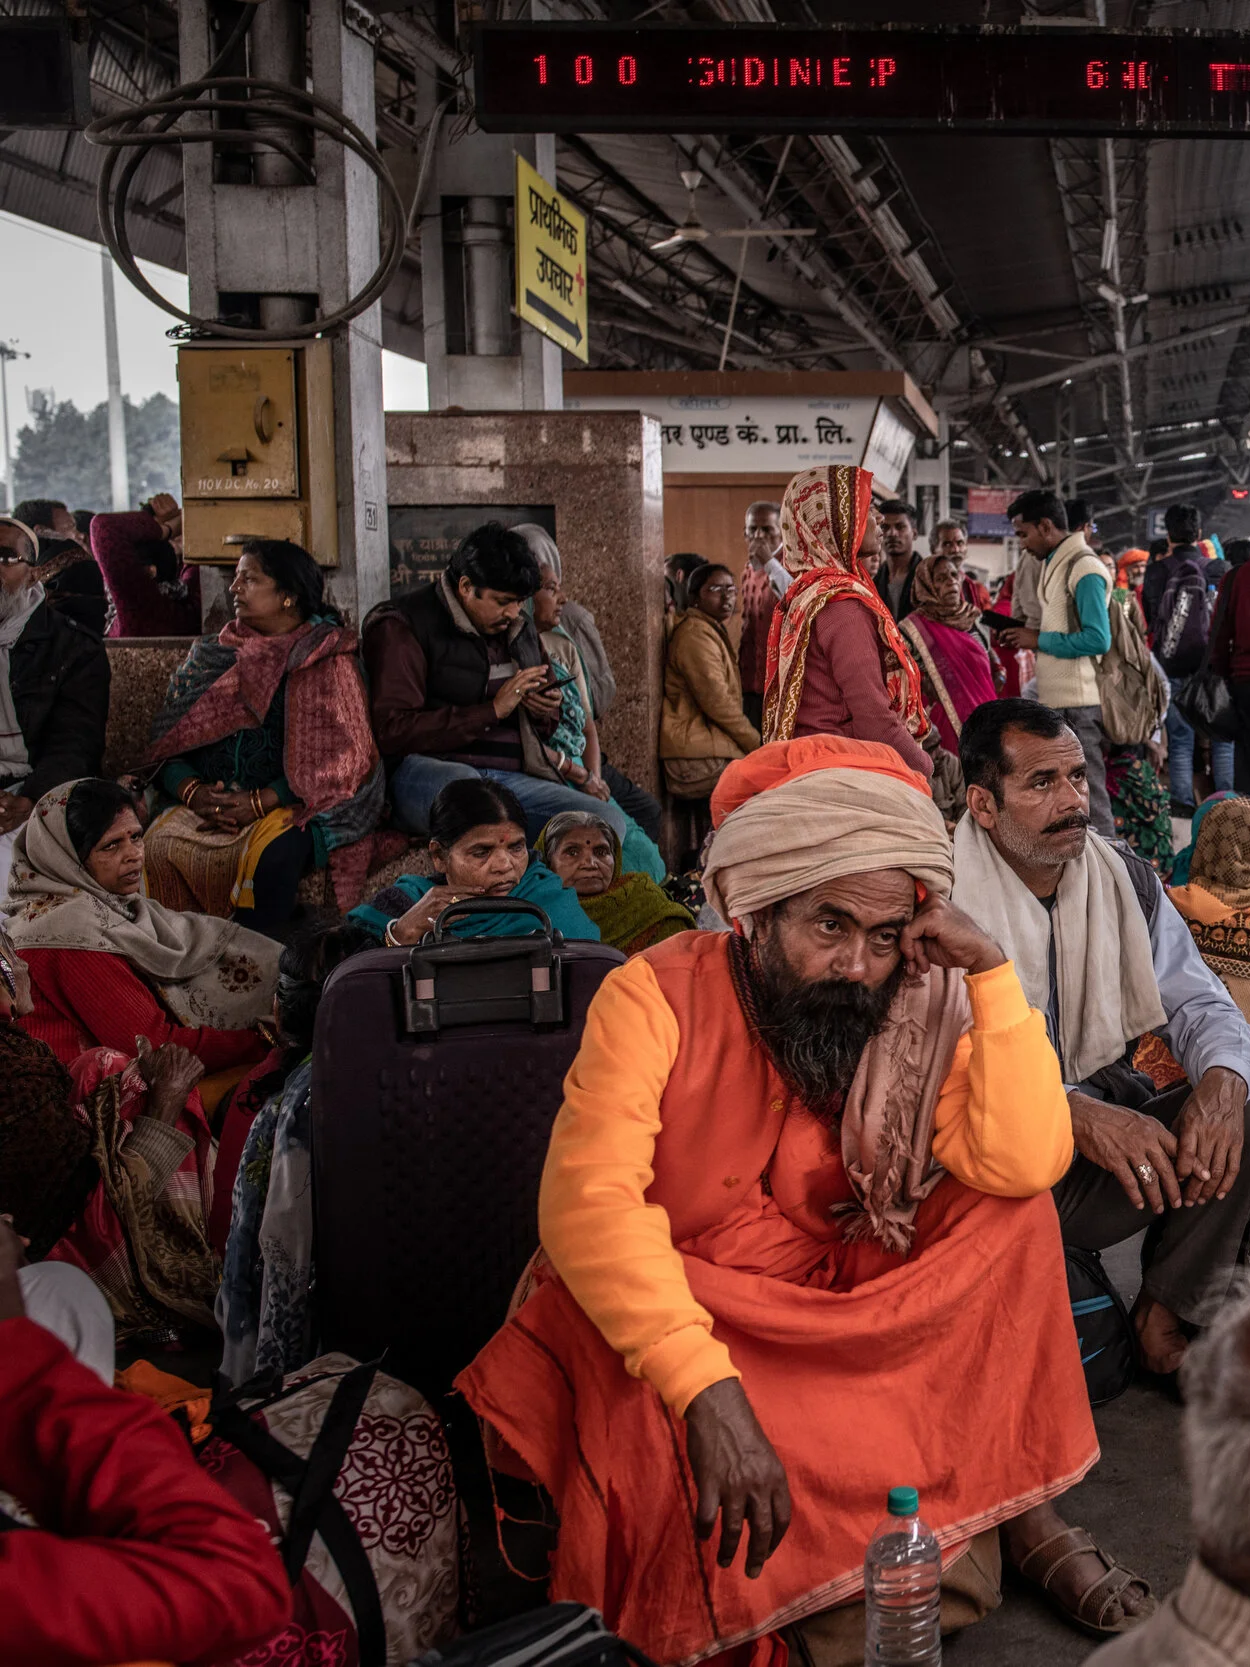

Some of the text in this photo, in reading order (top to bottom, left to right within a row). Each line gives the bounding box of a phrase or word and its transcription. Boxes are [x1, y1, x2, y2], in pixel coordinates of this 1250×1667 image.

[535, 246, 575, 306] उपचार
[689, 424, 730, 450] एण्ड
[736, 415, 768, 445] कं.
[775, 424, 808, 445] प्रा.
[815, 415, 853, 445] लि.
[263, 477, 280, 489] 20
[366, 506, 377, 526] 31
